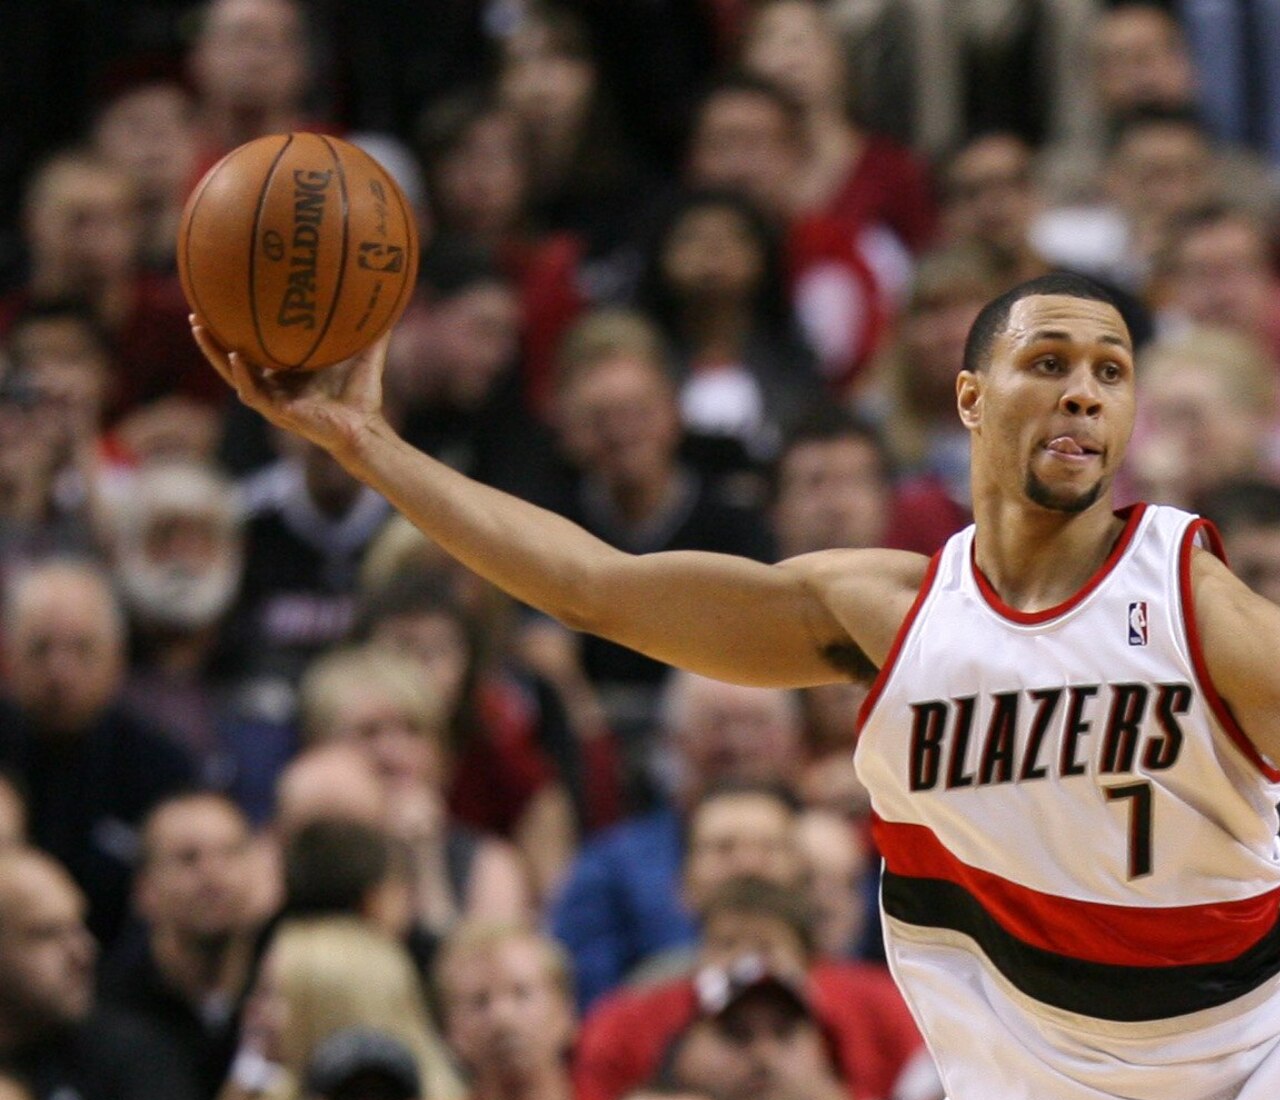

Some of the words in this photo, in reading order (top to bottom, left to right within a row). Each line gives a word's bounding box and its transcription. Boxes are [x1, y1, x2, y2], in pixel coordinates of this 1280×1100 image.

[278, 169, 332, 330] SPALDING
[908, 682, 1192, 792] BLAZERS
[1101, 778, 1154, 881] 7
